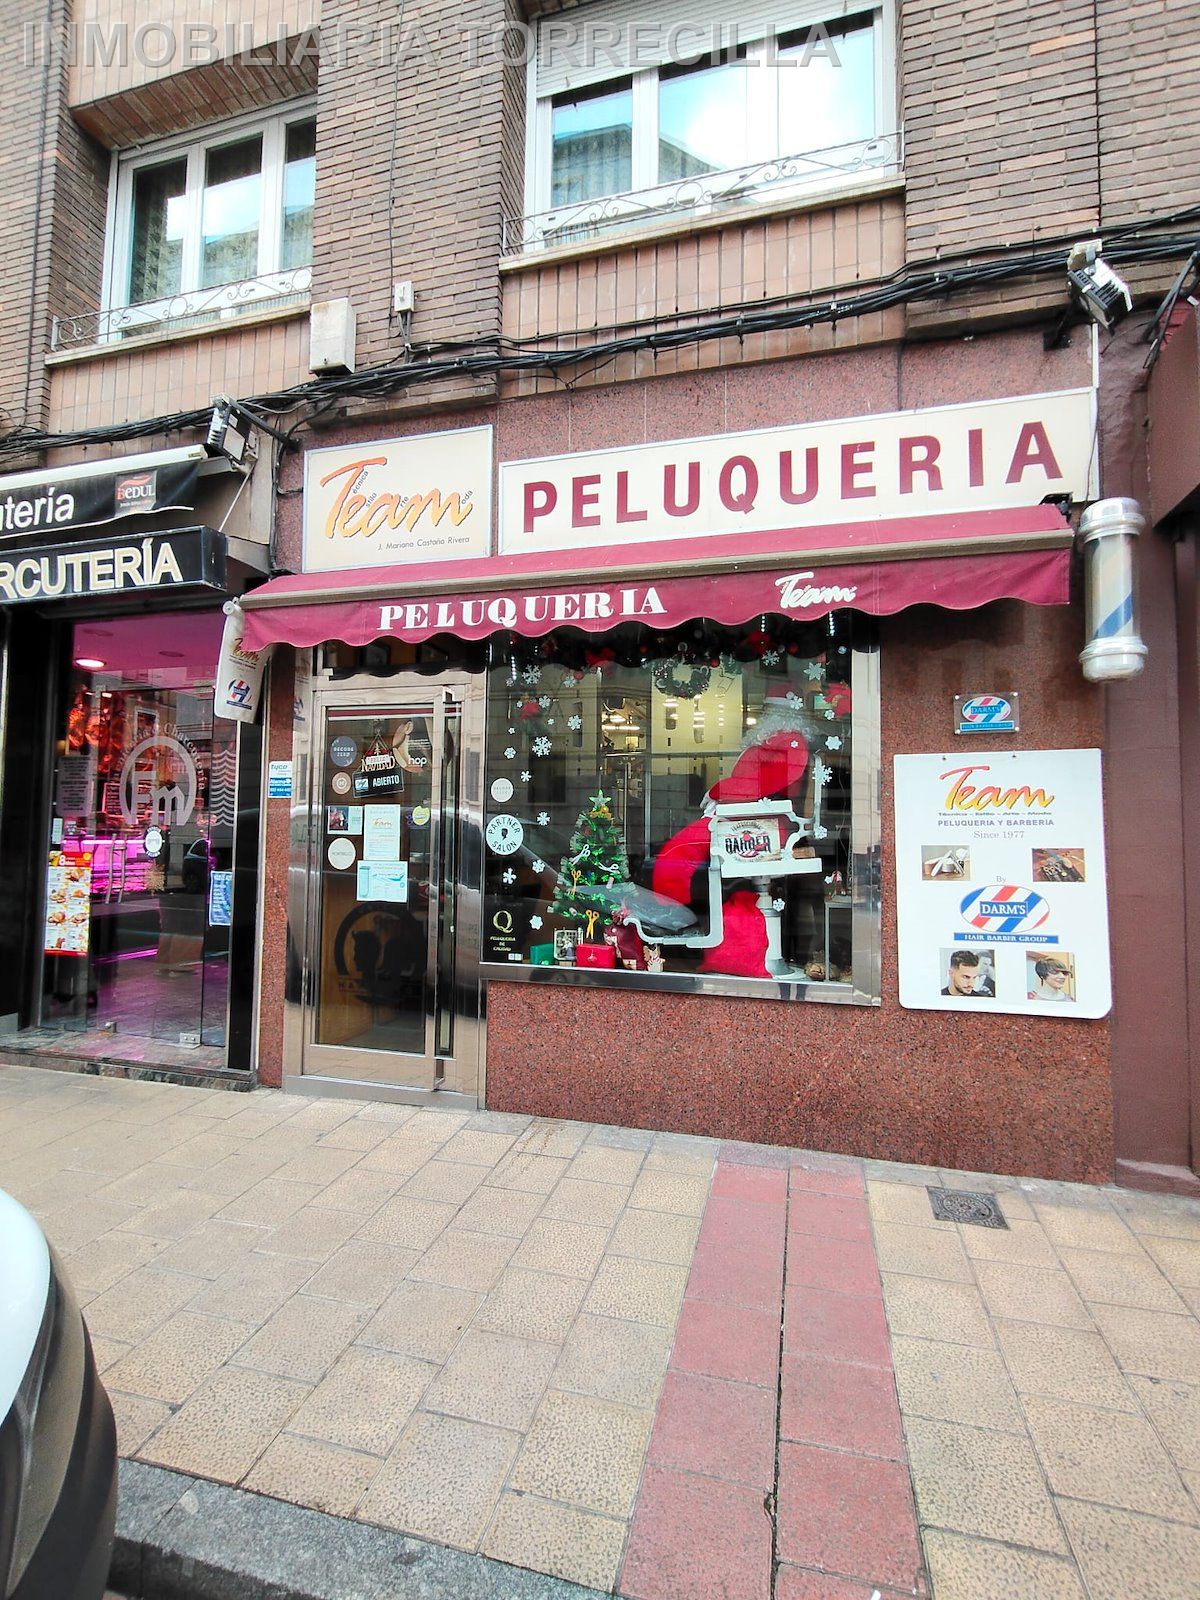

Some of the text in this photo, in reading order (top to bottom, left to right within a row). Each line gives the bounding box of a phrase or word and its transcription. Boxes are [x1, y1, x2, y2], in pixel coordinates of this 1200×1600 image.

[523, 421, 1063, 533] PELUQUERIA
[0, 486, 75, 531] tería
[320, 456, 474, 539] Team
[386, 541, 414, 549] Mariano
[447, 536, 470, 544] Rivera
[775, 571, 858, 609] Team
[376, 587, 667, 630] PELUQUERIA
[372, 775, 400, 787] ABIERTO
[939, 765, 1055, 811] Team
[488, 816, 520, 834] PARTNER
[973, 831, 1025, 839] Since 1977
[492, 841, 517, 852] SALON
[982, 904, 1026, 915] DARM'S
[493, 910, 513, 933] Q
